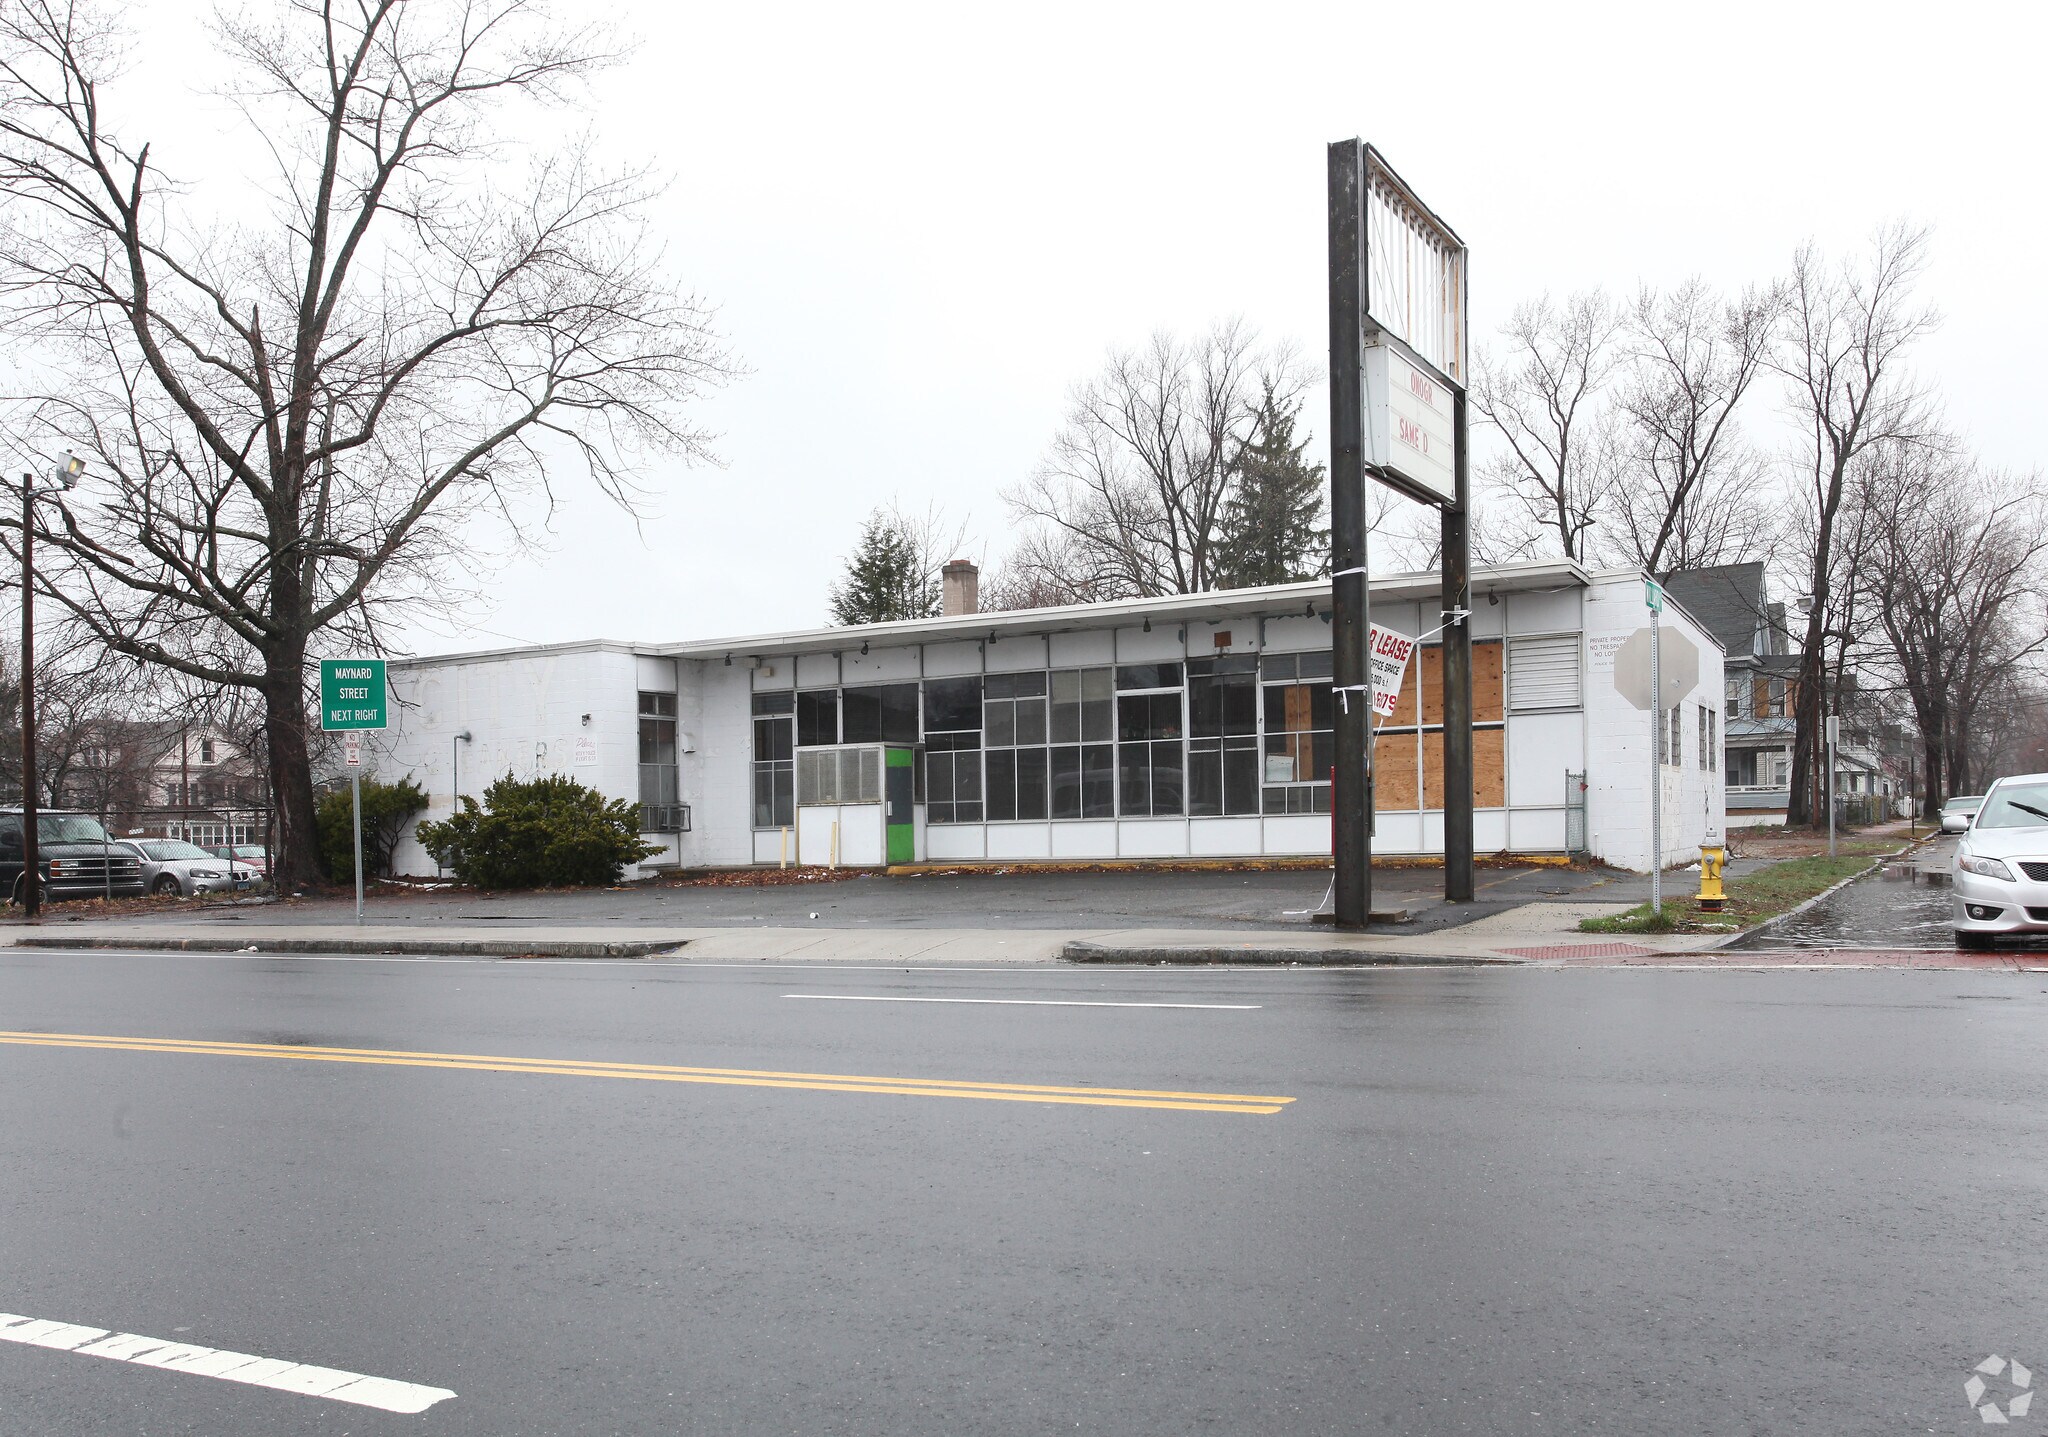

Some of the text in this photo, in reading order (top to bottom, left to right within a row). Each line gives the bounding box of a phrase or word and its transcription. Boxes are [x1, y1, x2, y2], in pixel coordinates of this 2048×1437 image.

[1399, 417, 1428, 453] SAME D
[1377, 633, 1411, 661] LEASE
[335, 668, 372, 679] MAYNARD
[1384, 663, 1400, 676] SPACE
[339, 688, 369, 699] STREET
[331, 709, 378, 721] NEXT RIGHT
